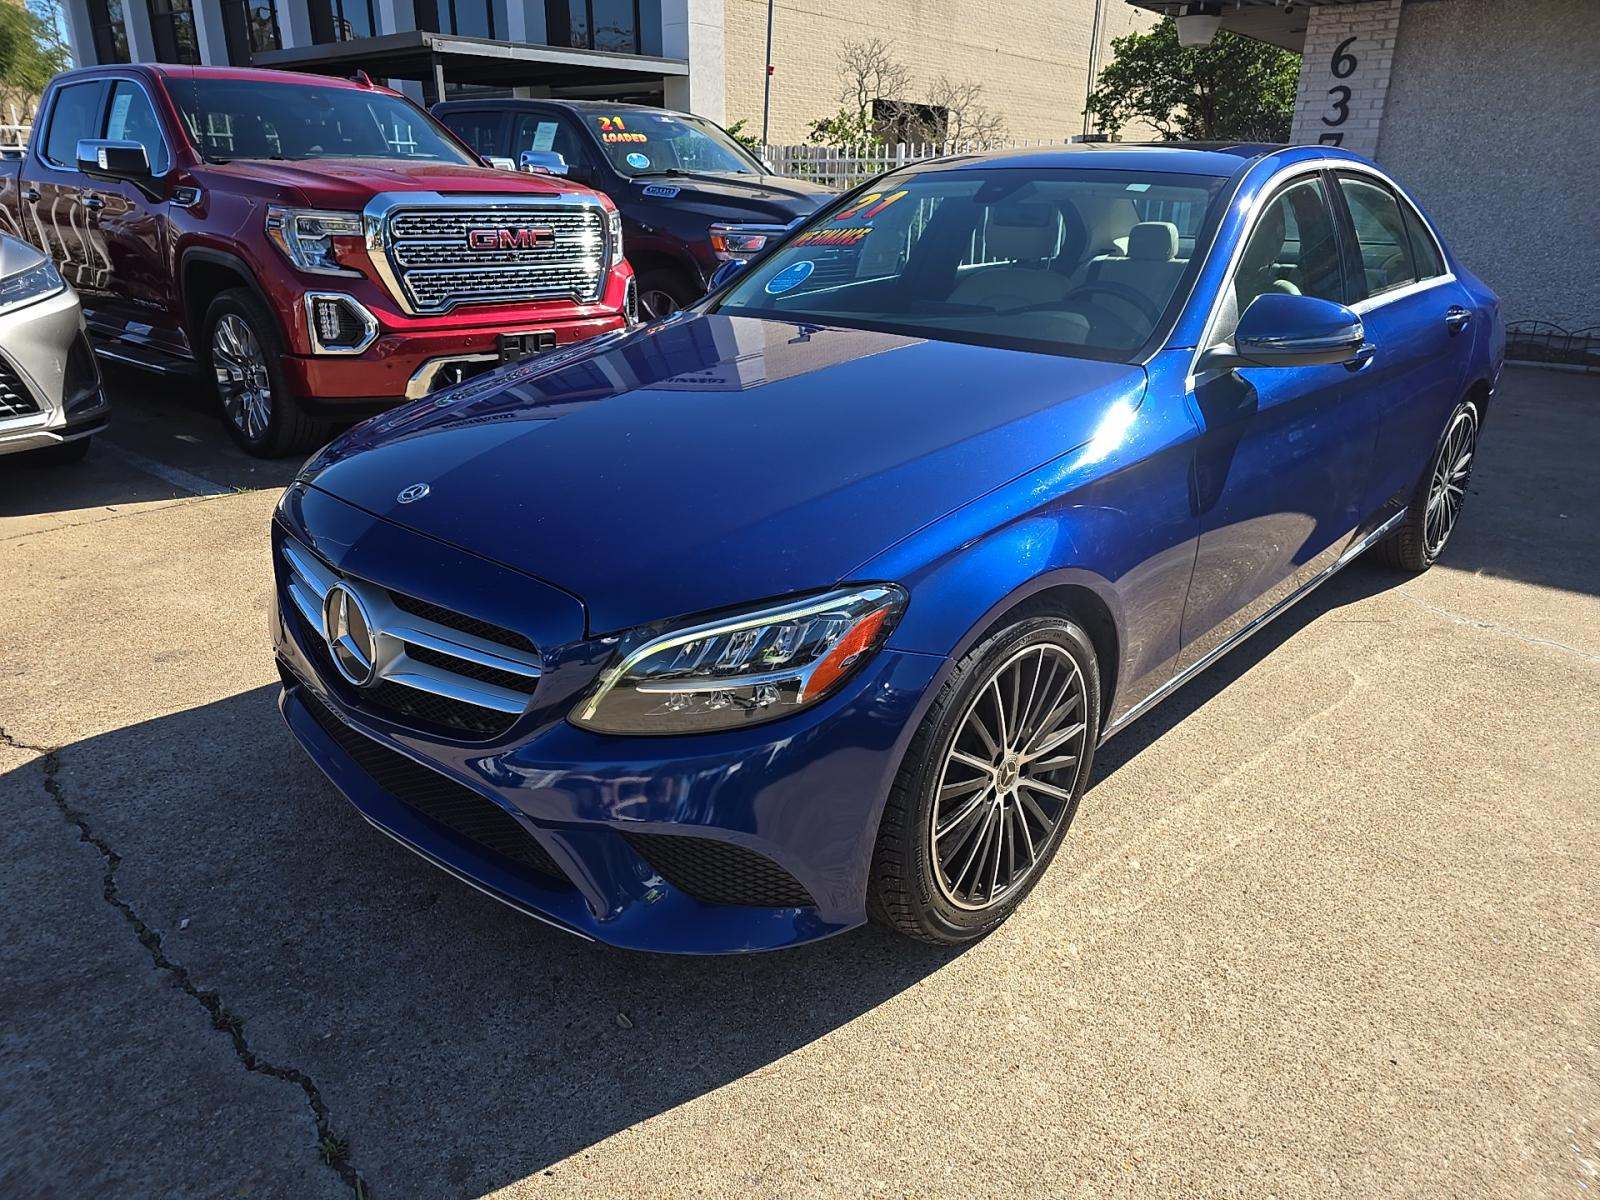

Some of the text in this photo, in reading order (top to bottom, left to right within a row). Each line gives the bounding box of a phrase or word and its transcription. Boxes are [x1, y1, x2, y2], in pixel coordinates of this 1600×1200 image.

[597, 116, 625, 131] 21
[602, 132, 648, 143] LOADED
[834, 190, 909, 220] 21
[469, 229, 555, 249] GMC
